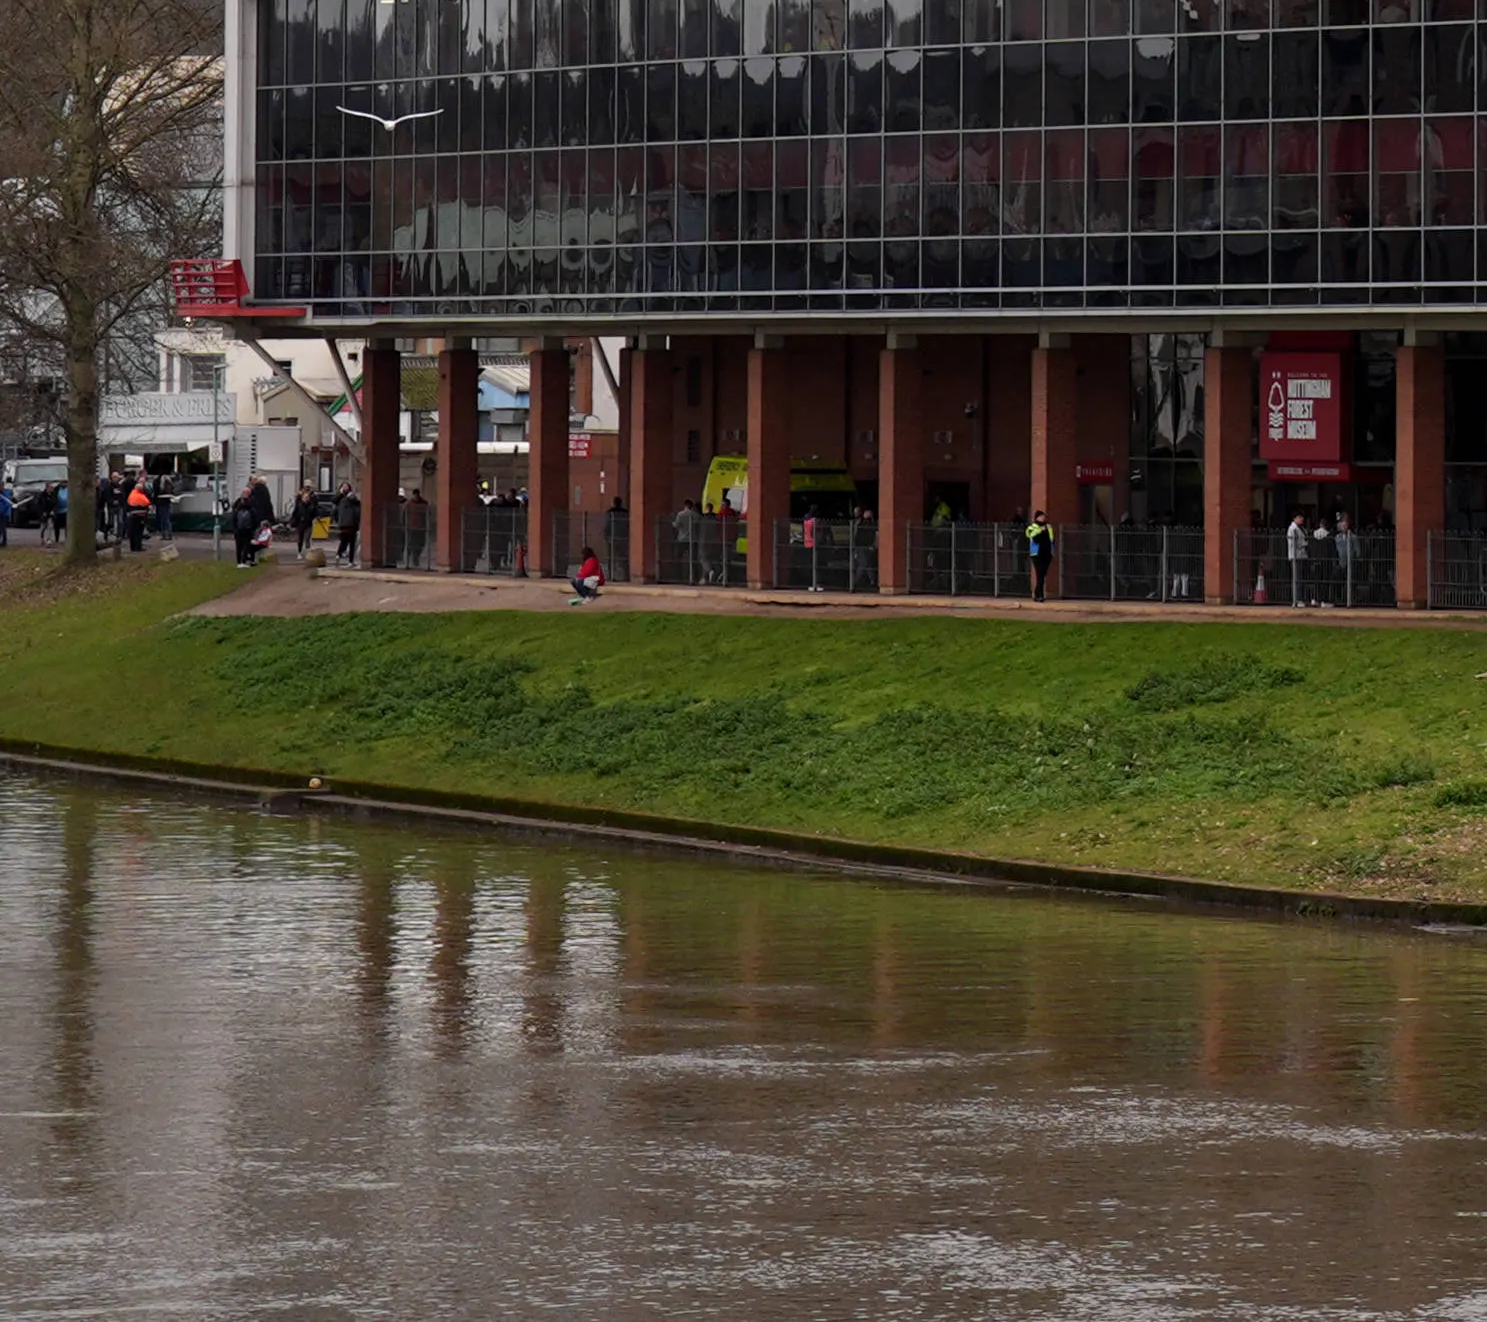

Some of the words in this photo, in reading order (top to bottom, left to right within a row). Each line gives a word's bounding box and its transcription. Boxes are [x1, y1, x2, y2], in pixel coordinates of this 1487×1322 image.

[1287, 379, 1331, 399] NOTTINGHAM
[1287, 399, 1313, 419] FOREST
[1287, 420, 1316, 440] MUSEUM
